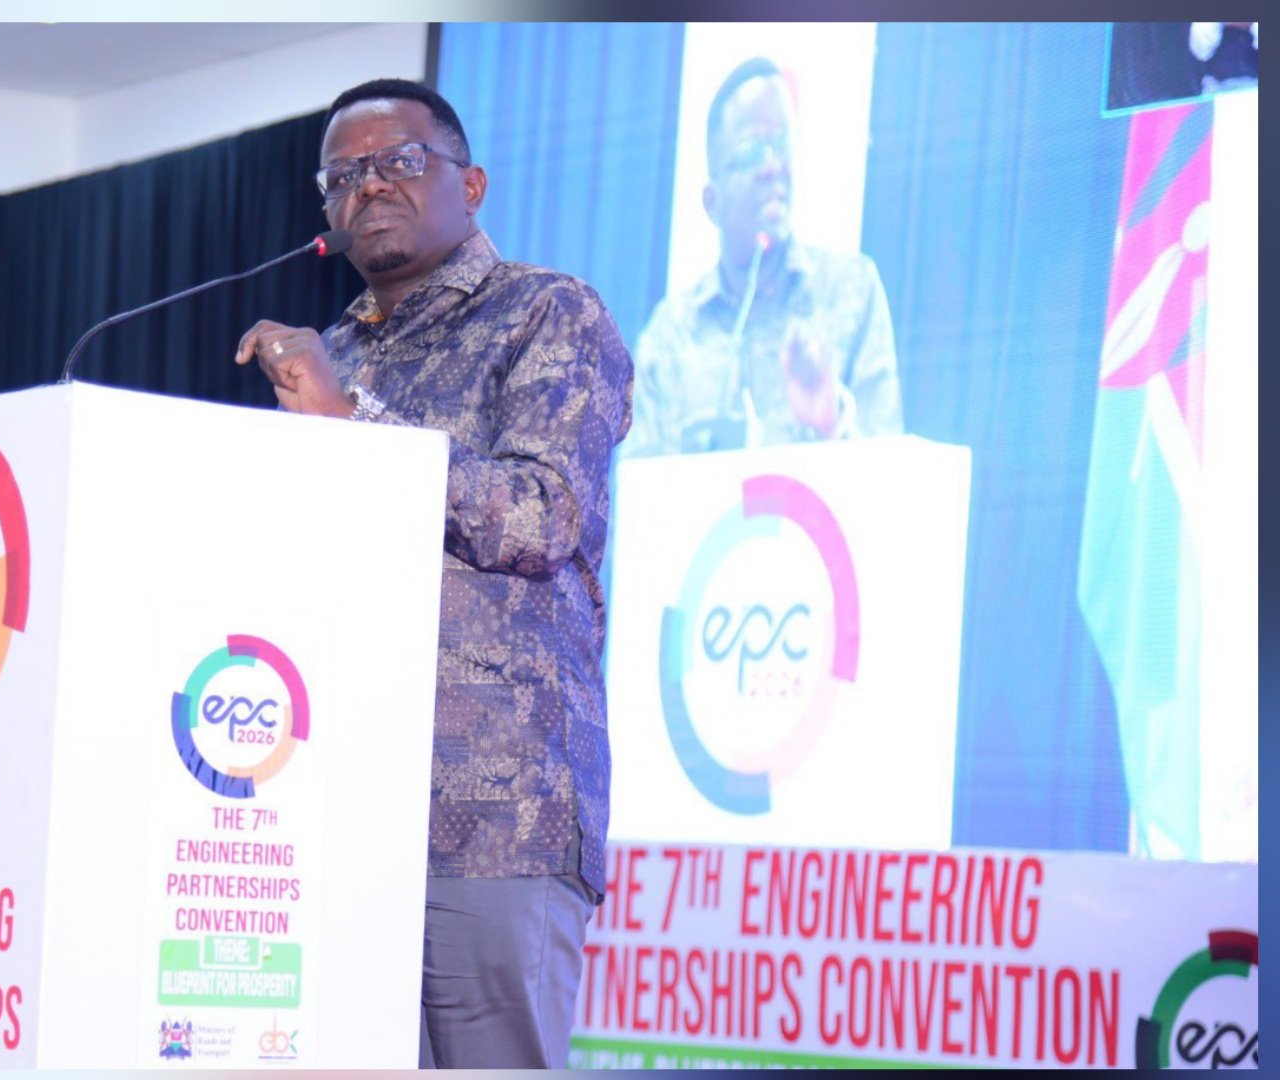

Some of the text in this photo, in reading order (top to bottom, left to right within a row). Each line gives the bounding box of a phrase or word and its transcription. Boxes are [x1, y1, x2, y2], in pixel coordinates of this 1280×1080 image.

[202, 694, 279, 743] epc
[236, 729, 276, 746] 2026
[212, 806, 278, 832] THE 7TH
[175, 839, 294, 868] ENGINEERING
[166, 872, 301, 902] PARTNERSHIPS
[661, 848, 724, 934] 7TH
[739, 849, 1044, 951] ENGINEERING
[175, 907, 290, 935] CONVENTION
[819, 953, 1120, 1068] CONVENTION
